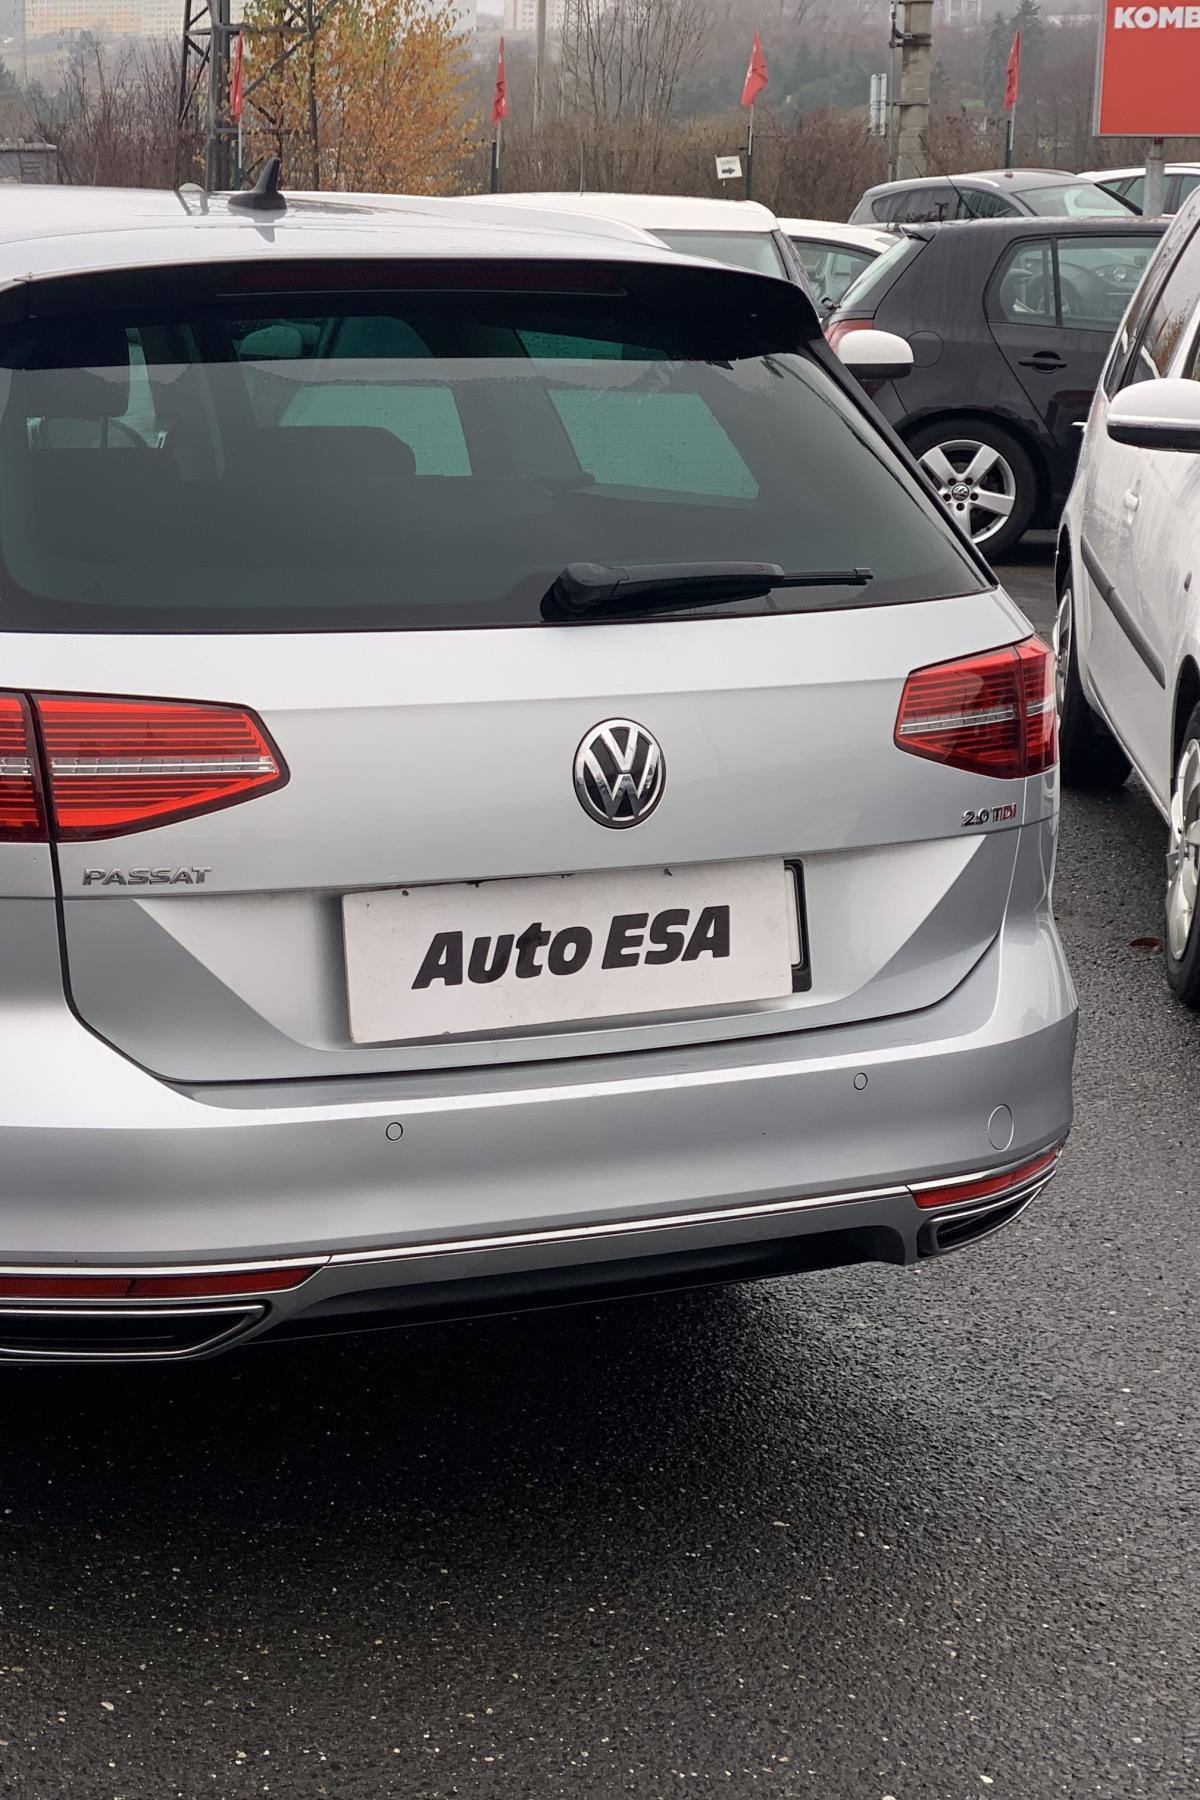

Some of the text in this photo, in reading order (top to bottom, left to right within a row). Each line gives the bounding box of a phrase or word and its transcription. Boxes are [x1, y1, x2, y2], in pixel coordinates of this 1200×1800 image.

[961, 803, 1016, 827] 2.0 TDI
[82, 866, 213, 886] PASSAT
[411, 905, 731, 990] Auto ESA
